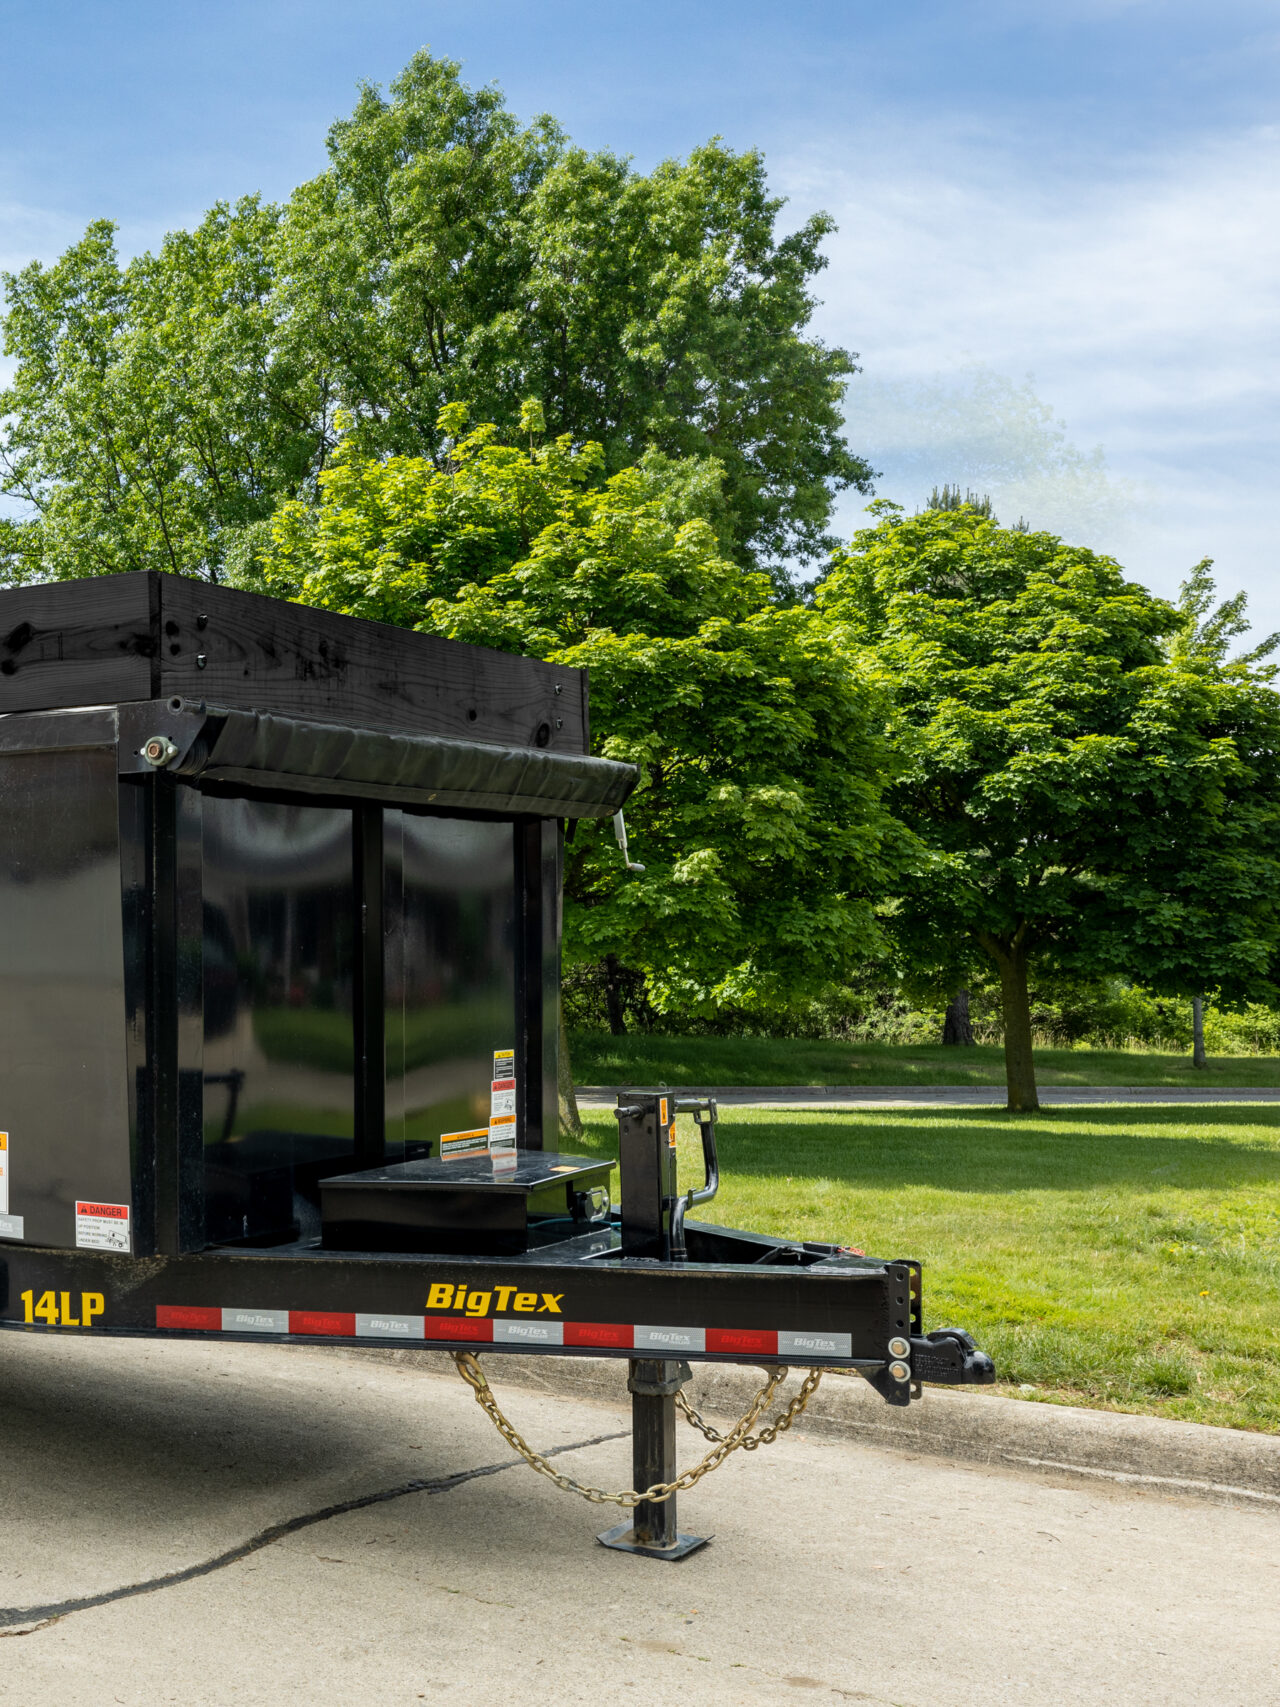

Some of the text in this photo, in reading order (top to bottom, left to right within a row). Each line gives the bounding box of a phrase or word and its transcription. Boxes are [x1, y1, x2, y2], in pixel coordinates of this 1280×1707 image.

[89, 1205, 122, 1217] DANGER
[20, 1289, 105, 1327] 14LP
[425, 1283, 564, 1317] BigTex
[235, 1314, 274, 1326] BigTex
[370, 1320, 409, 1331] BigTex
[508, 1325, 548, 1336] BigTex
[649, 1332, 690, 1343] BigTex
[794, 1337, 836, 1349] BigTex
